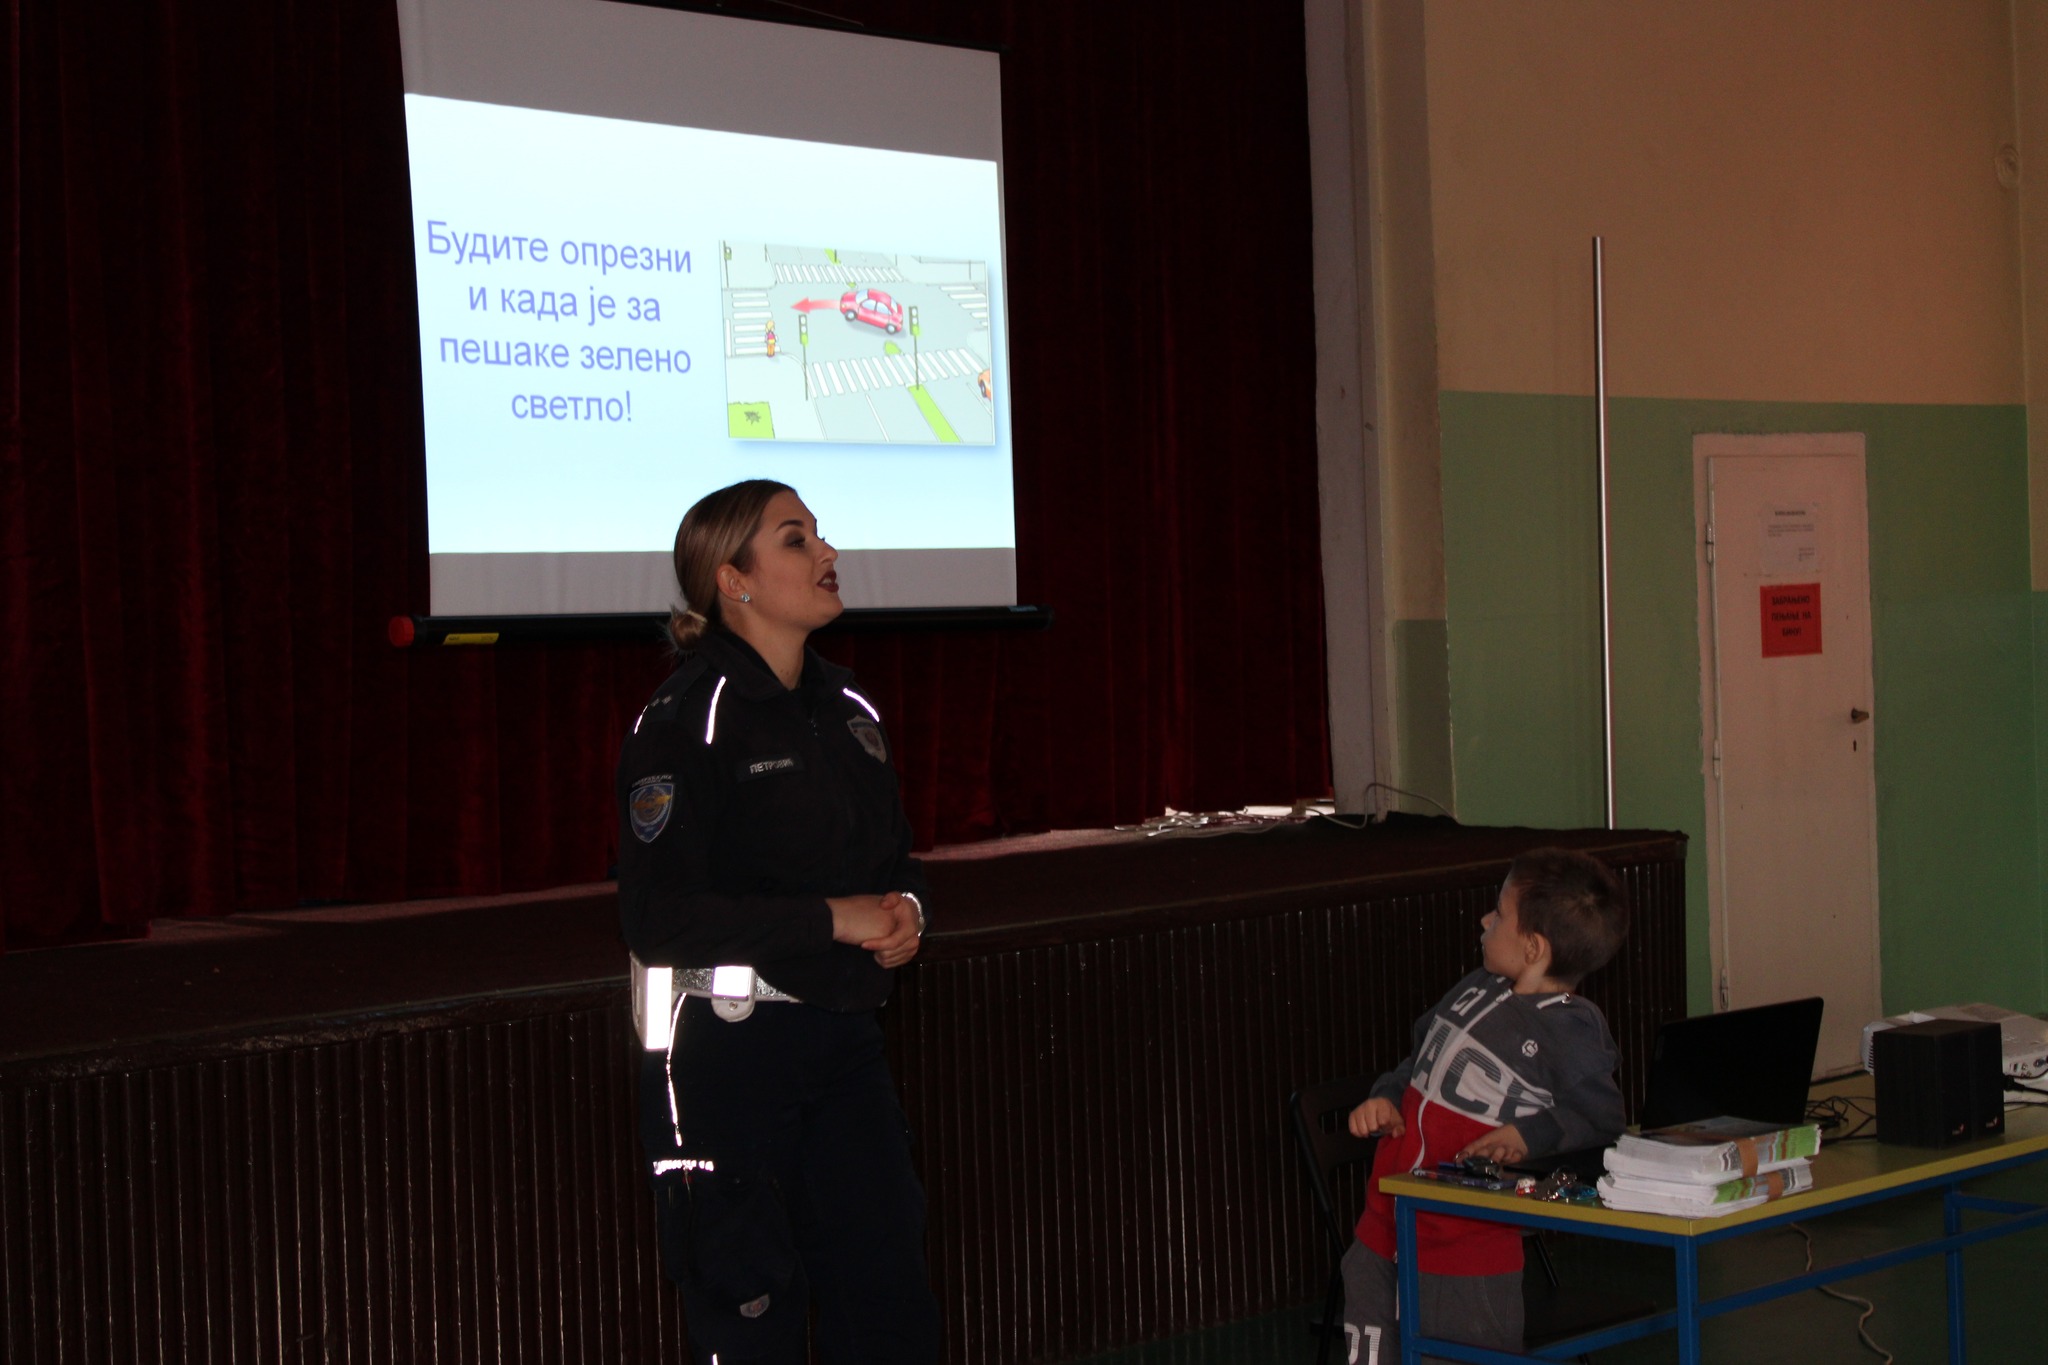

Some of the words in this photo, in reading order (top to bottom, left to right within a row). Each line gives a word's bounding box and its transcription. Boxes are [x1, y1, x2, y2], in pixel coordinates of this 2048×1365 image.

[427, 220, 549, 265] Будите
[560, 240, 692, 275] опрезни
[468, 286, 488, 311] и
[500, 288, 578, 322] када
[588, 286, 616, 327] је
[627, 297, 661, 321] за
[440, 337, 570, 368] пешаке
[580, 345, 691, 374] зелено
[511, 390, 632, 422] светло!
